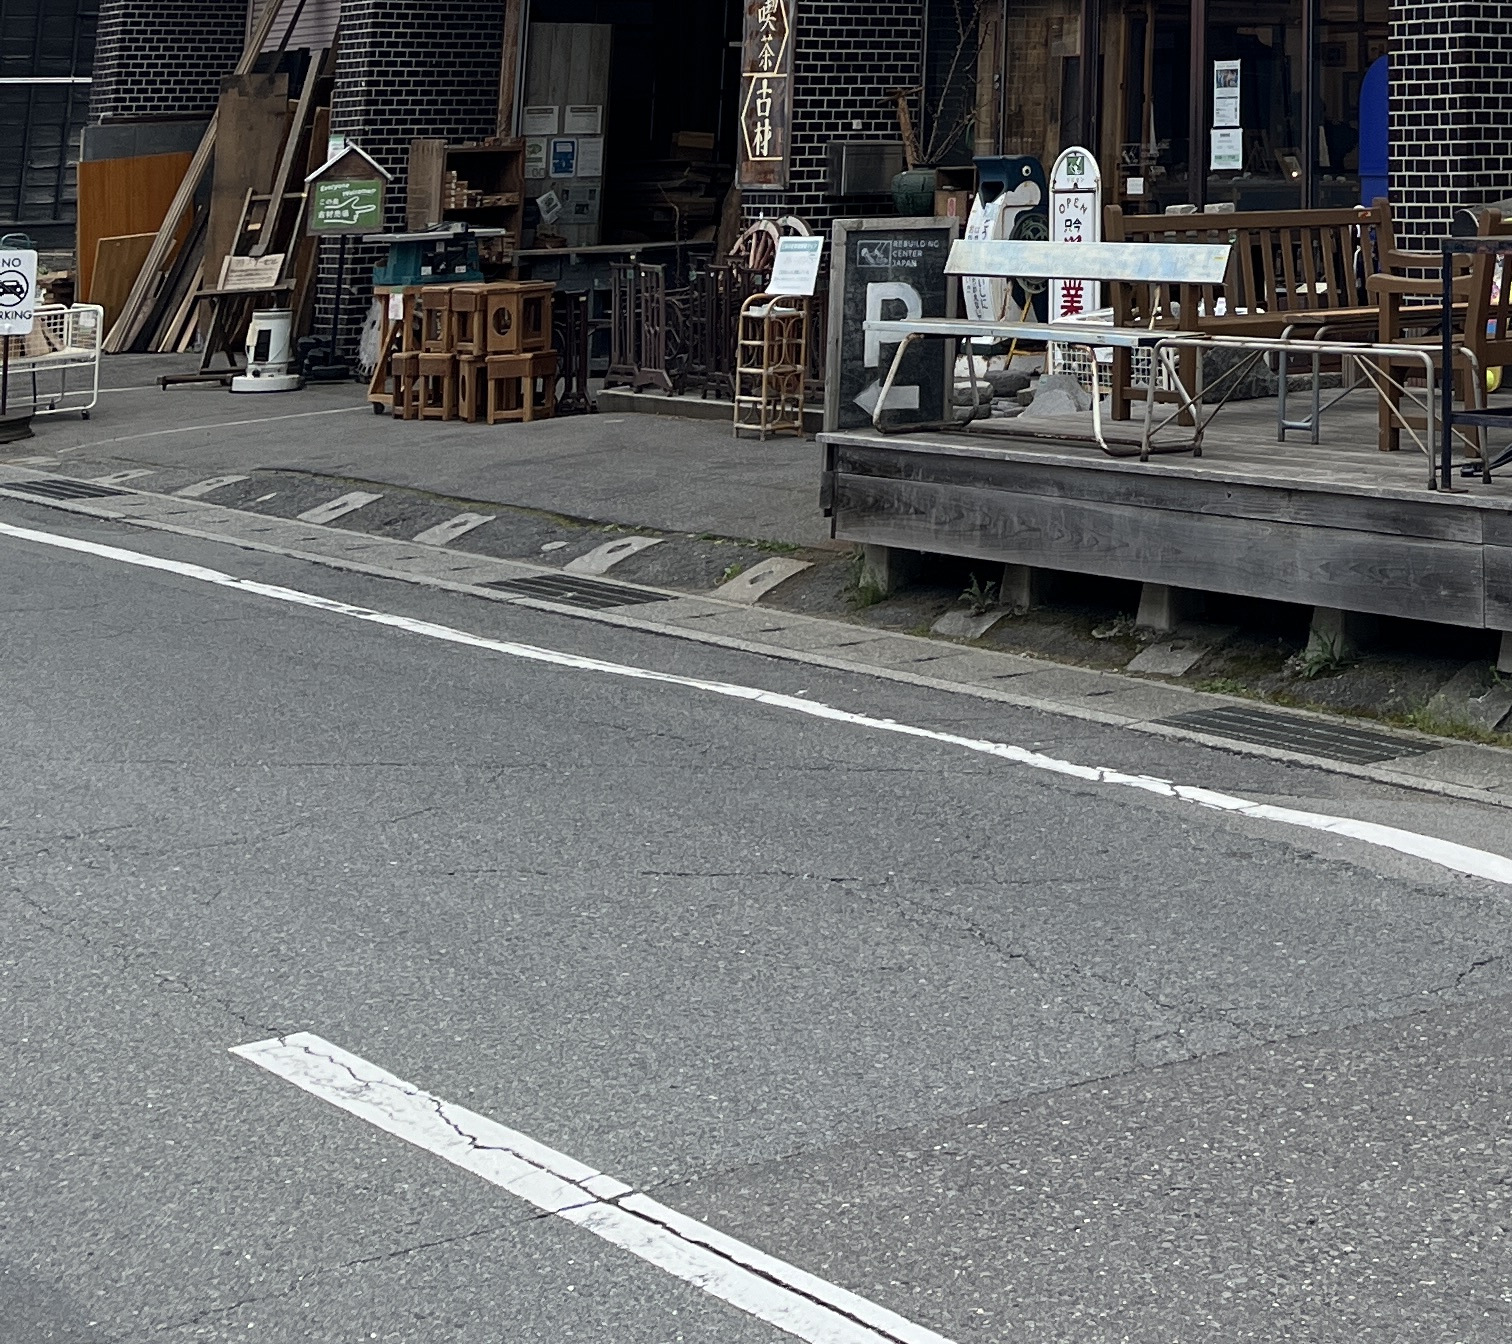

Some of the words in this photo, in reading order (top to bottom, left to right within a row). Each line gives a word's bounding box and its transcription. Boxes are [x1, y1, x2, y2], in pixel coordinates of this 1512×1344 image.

[752, 79, 773, 157] 古材
[1059, 197, 1087, 214] OPEN
[1064, 218, 1082, 233] 只今
[892, 250, 923, 258] CENTER
[2, 258, 21, 267] NO
[892, 259, 918, 268] JAPAN
[863, 282, 923, 368] P
